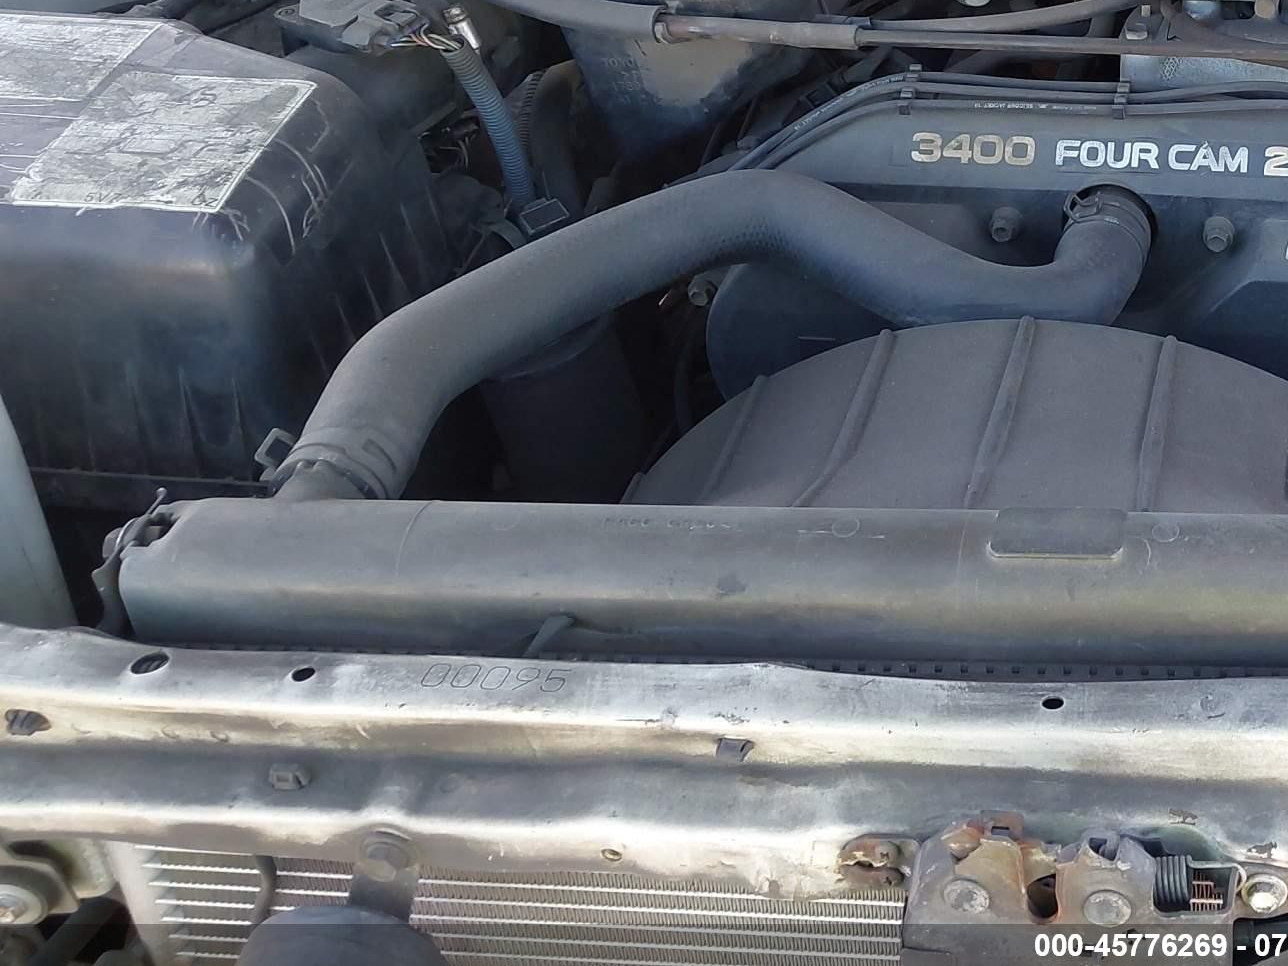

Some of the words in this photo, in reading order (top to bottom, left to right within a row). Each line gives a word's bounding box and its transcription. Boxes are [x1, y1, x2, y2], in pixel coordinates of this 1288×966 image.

[911, 132, 1036, 166] 3400
[1055, 139, 1160, 169] FOUR
[1168, 143, 1249, 174] CAM
[420, 663, 573, 693] 00095
